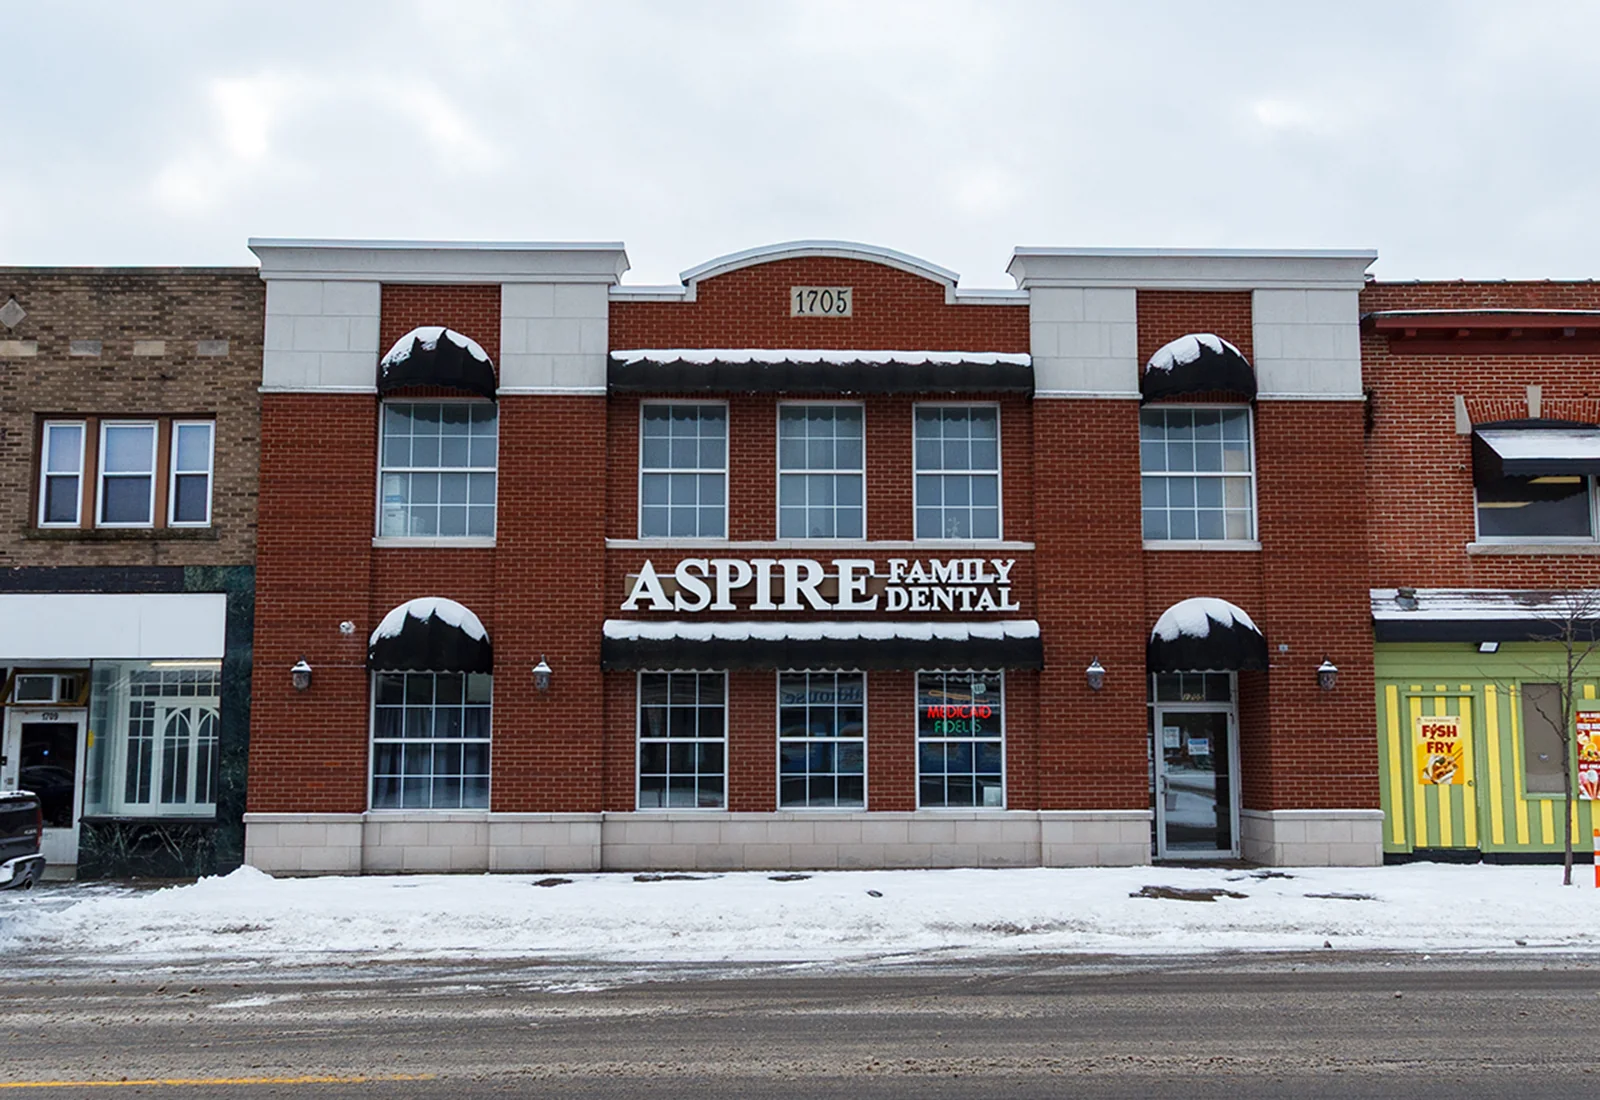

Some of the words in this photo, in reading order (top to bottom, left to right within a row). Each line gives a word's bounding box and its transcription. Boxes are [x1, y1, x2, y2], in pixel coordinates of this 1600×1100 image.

[796, 289, 848, 314] 1705
[887, 558, 1016, 584] FAMILY
[620, 558, 879, 612] ASPIRE
[885, 586, 1020, 612] DENTAL
[927, 705, 992, 719] MEDICAID
[934, 719, 982, 733] FIDELIS
[1422, 723, 1457, 740] FISH
[1426, 741, 1455, 754] FRY
